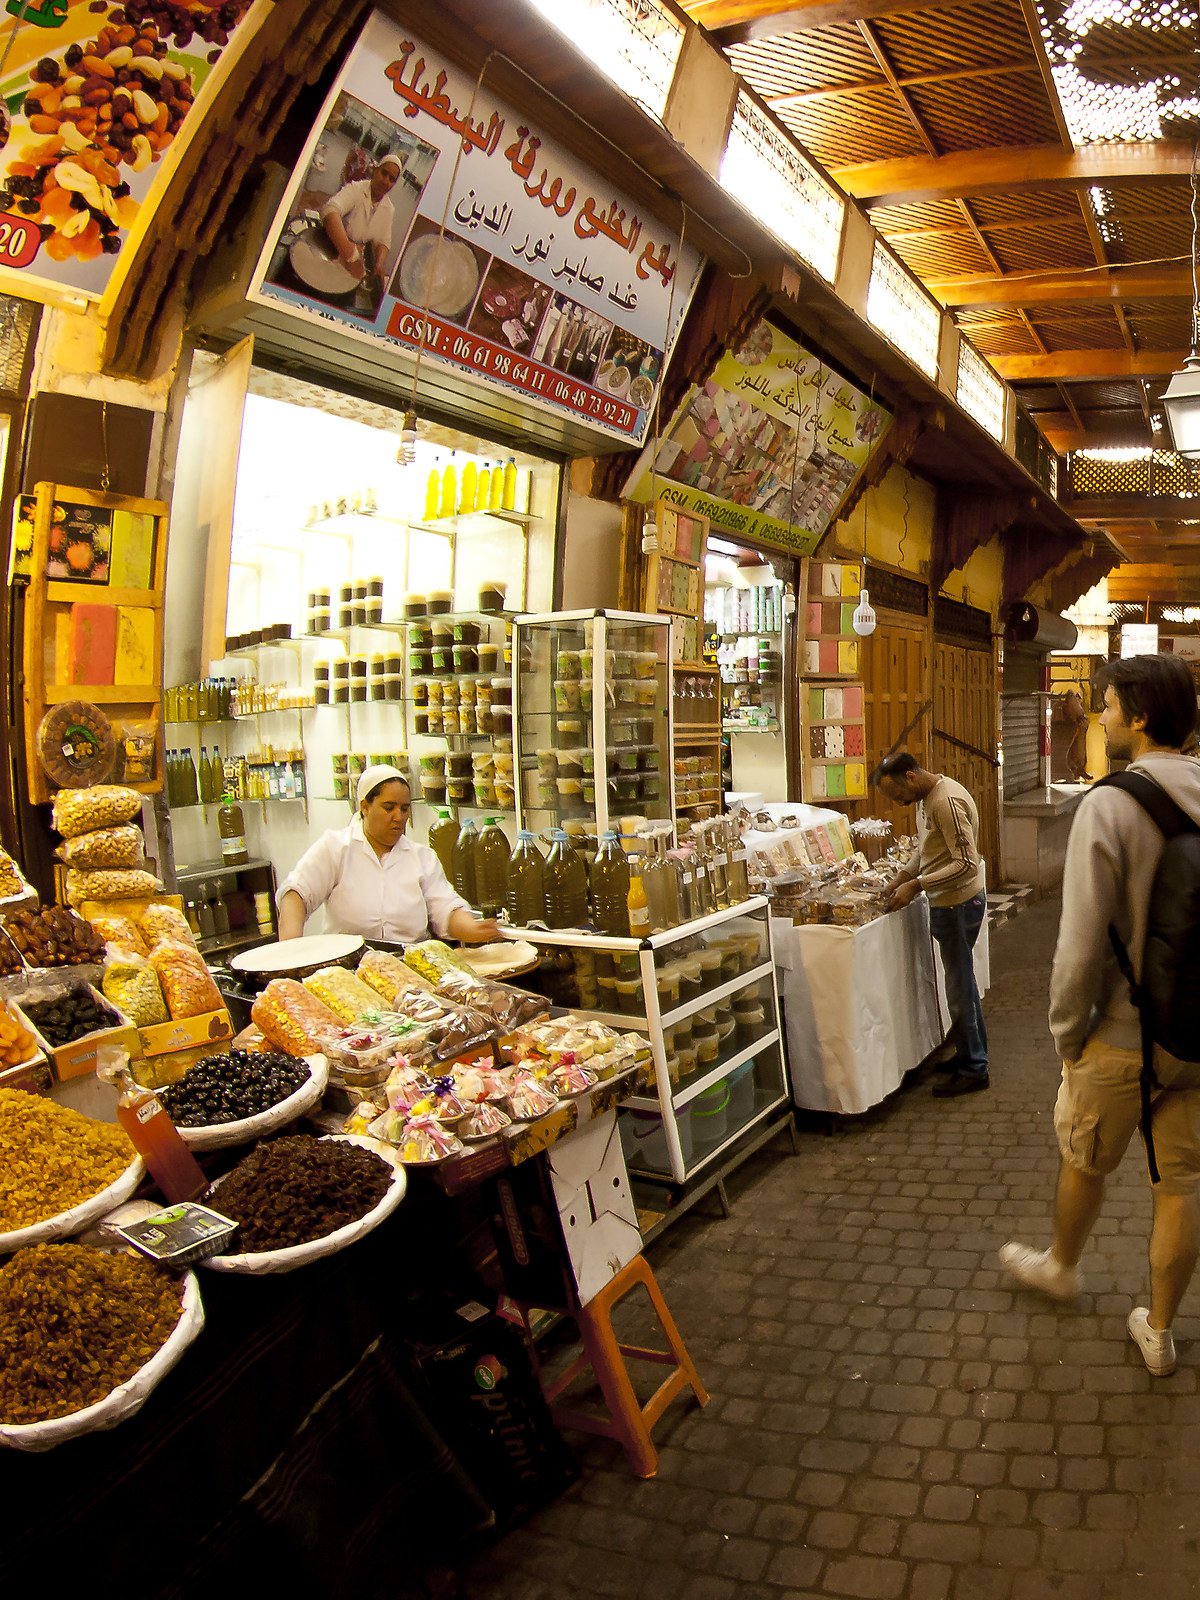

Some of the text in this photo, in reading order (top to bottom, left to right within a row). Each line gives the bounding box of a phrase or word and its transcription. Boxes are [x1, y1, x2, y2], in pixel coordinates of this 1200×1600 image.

[384, 40, 505, 157] البسطيلة
[453, 189, 639, 312] عند صابر نور الدين
[574, 197, 642, 254] الخليع
[398, 313, 441, 348] GSM
[452, 336, 473, 360] 06
[473, 345, 491, 368] 61
[492, 353, 511, 376] 98
[512, 362, 530, 383] 64
[530, 370, 546, 391] 11
[554, 380, 571, 401] 06
[571, 388, 587, 408] 48
[588, 394, 602, 414] 73
[602, 401, 617, 421] 92
[616, 408, 631, 427] 20
[735, 370, 771, 402] باللوز
[827, 429, 854, 451] جميع
